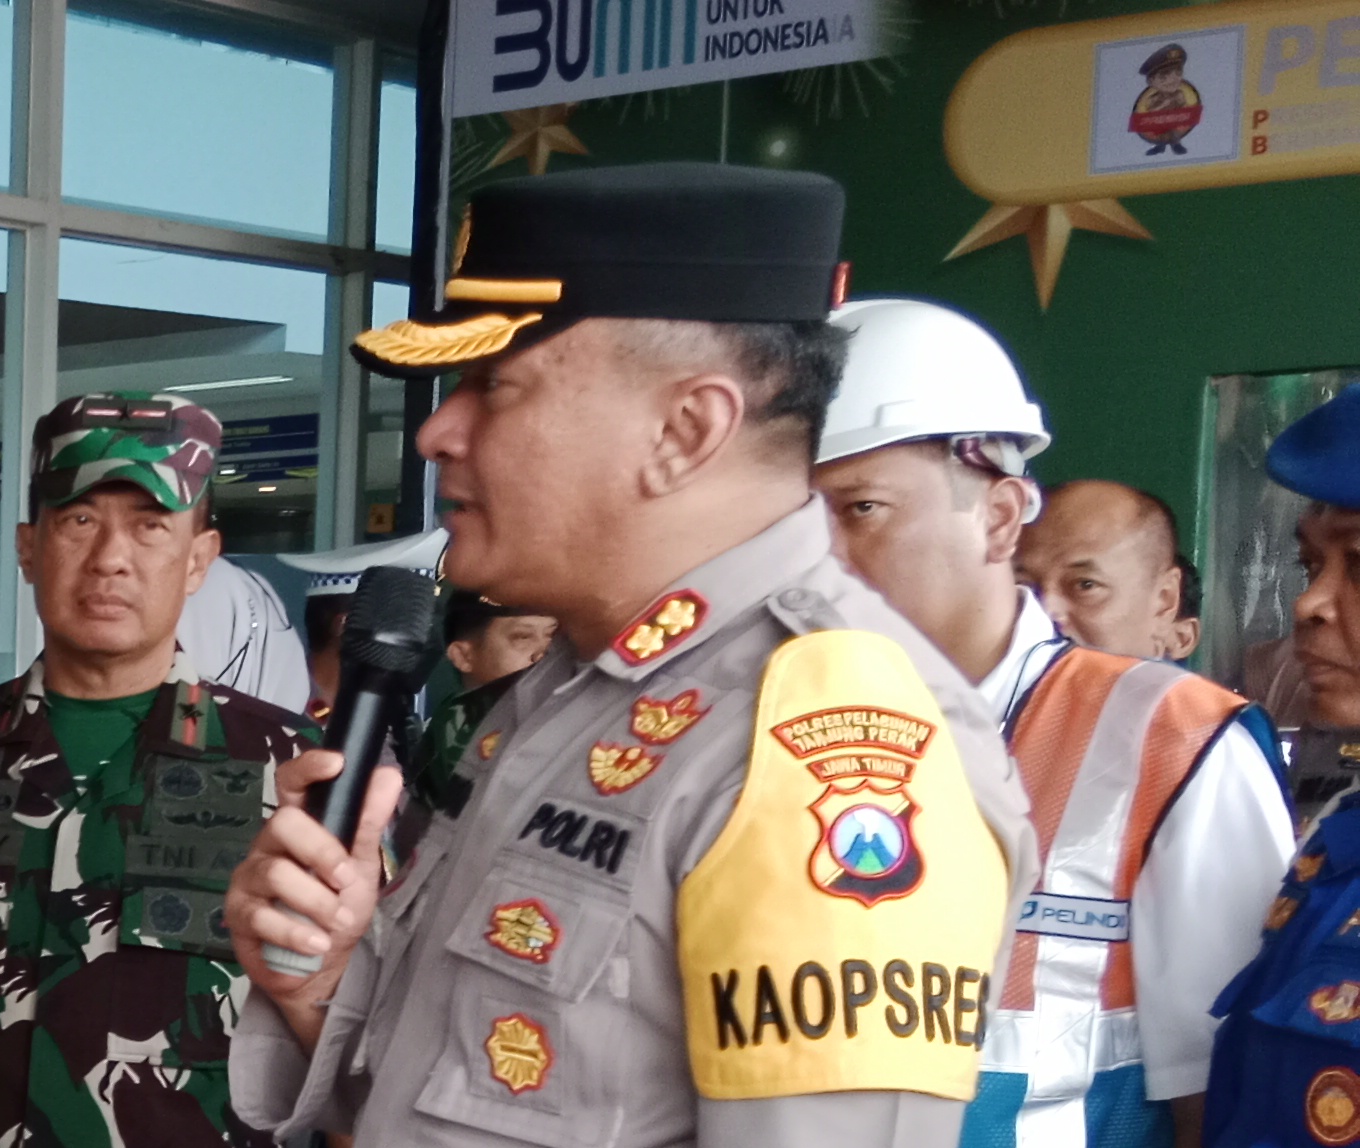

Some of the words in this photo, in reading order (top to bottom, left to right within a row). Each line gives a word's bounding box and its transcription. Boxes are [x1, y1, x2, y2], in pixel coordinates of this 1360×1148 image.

[704, 17, 830, 62] INDONESIA
[139, 843, 196, 869] TNI
[518, 802, 631, 874] POLRI
